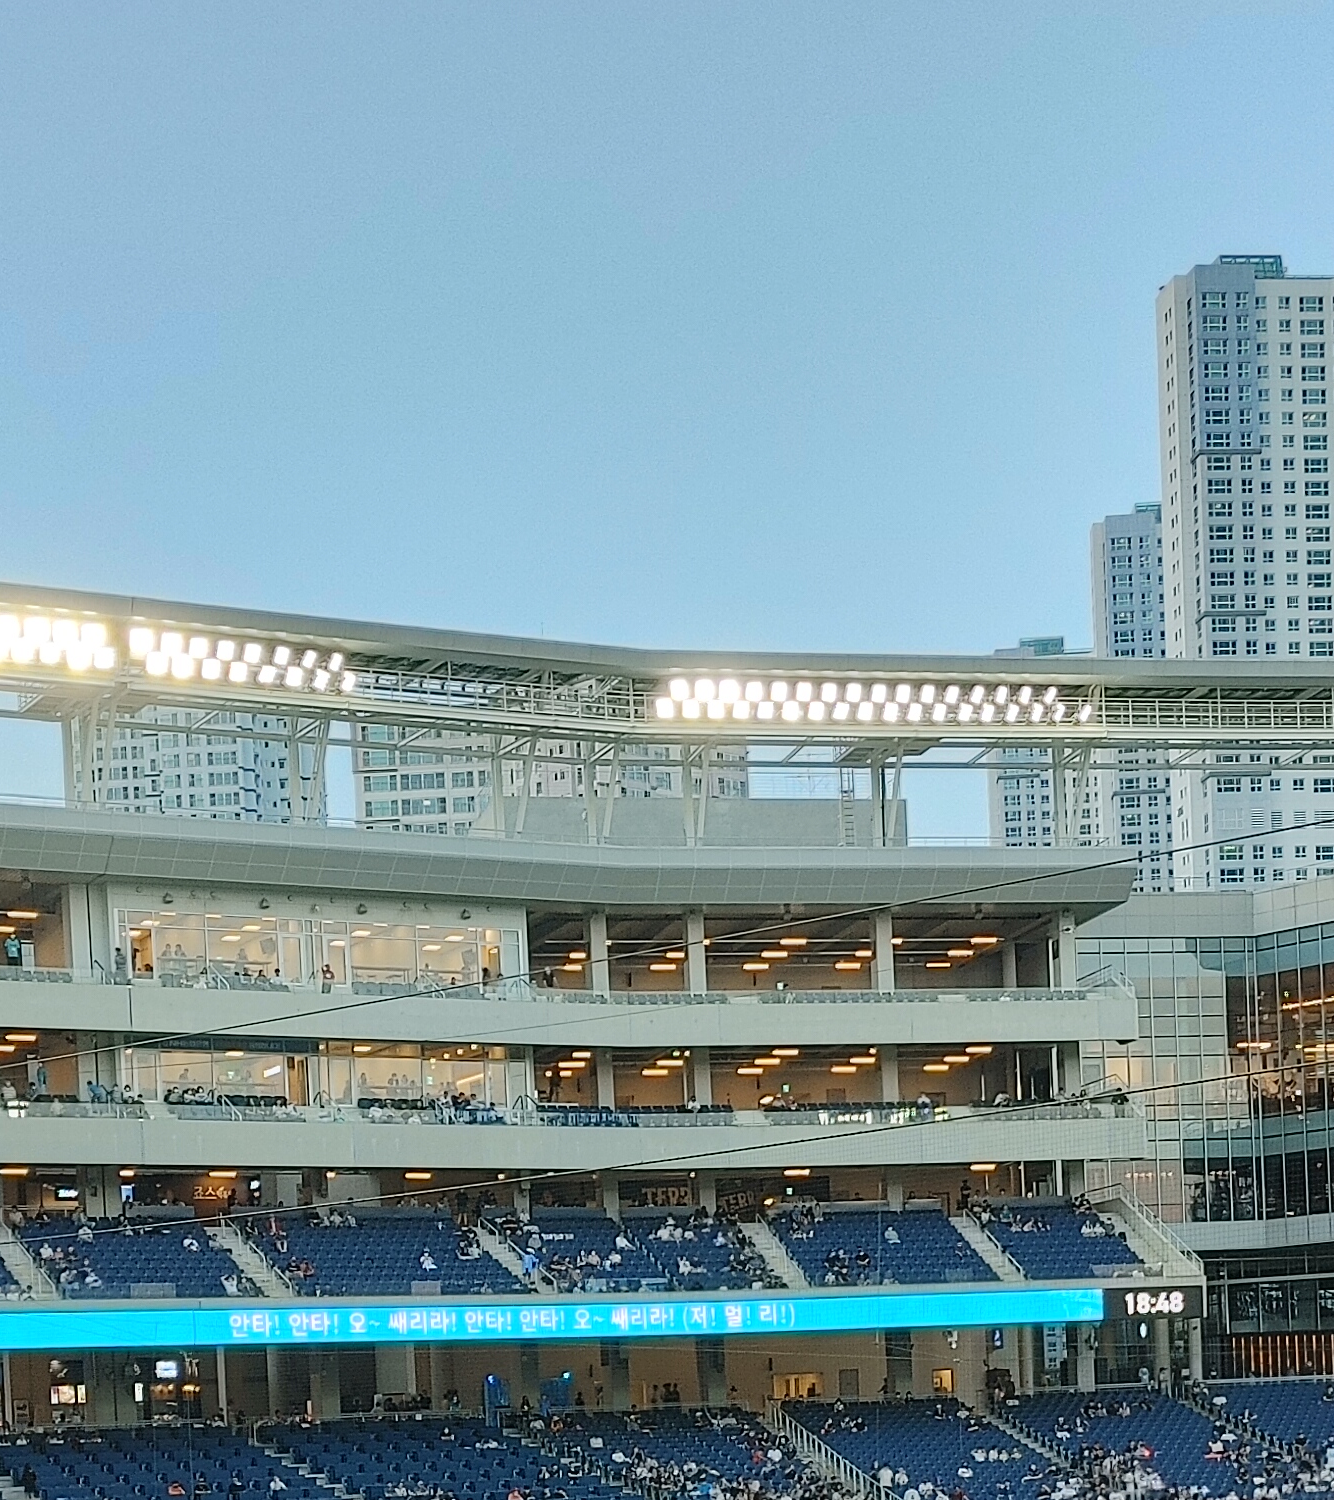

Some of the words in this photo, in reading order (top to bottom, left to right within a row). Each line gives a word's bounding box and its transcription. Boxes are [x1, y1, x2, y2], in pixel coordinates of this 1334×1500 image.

[1124, 1291, 1185, 1316] 18:48
[230, 1313, 281, 1338] 안타!
[289, 1312, 339, 1337] 안타!
[349, 1312, 381, 1334] 오~
[388, 1310, 457, 1335] 쌔리라!
[465, 1309, 512, 1333] 안타!
[520, 1309, 566, 1332] 안타!
[574, 1308, 605, 1330] 오~
[611, 1306, 675, 1331] 쌔리라!
[682, 1305, 716, 1331] (저!
[725, 1305, 751, 1328] 멀!
[760, 1303, 796, 1328] 리!)
